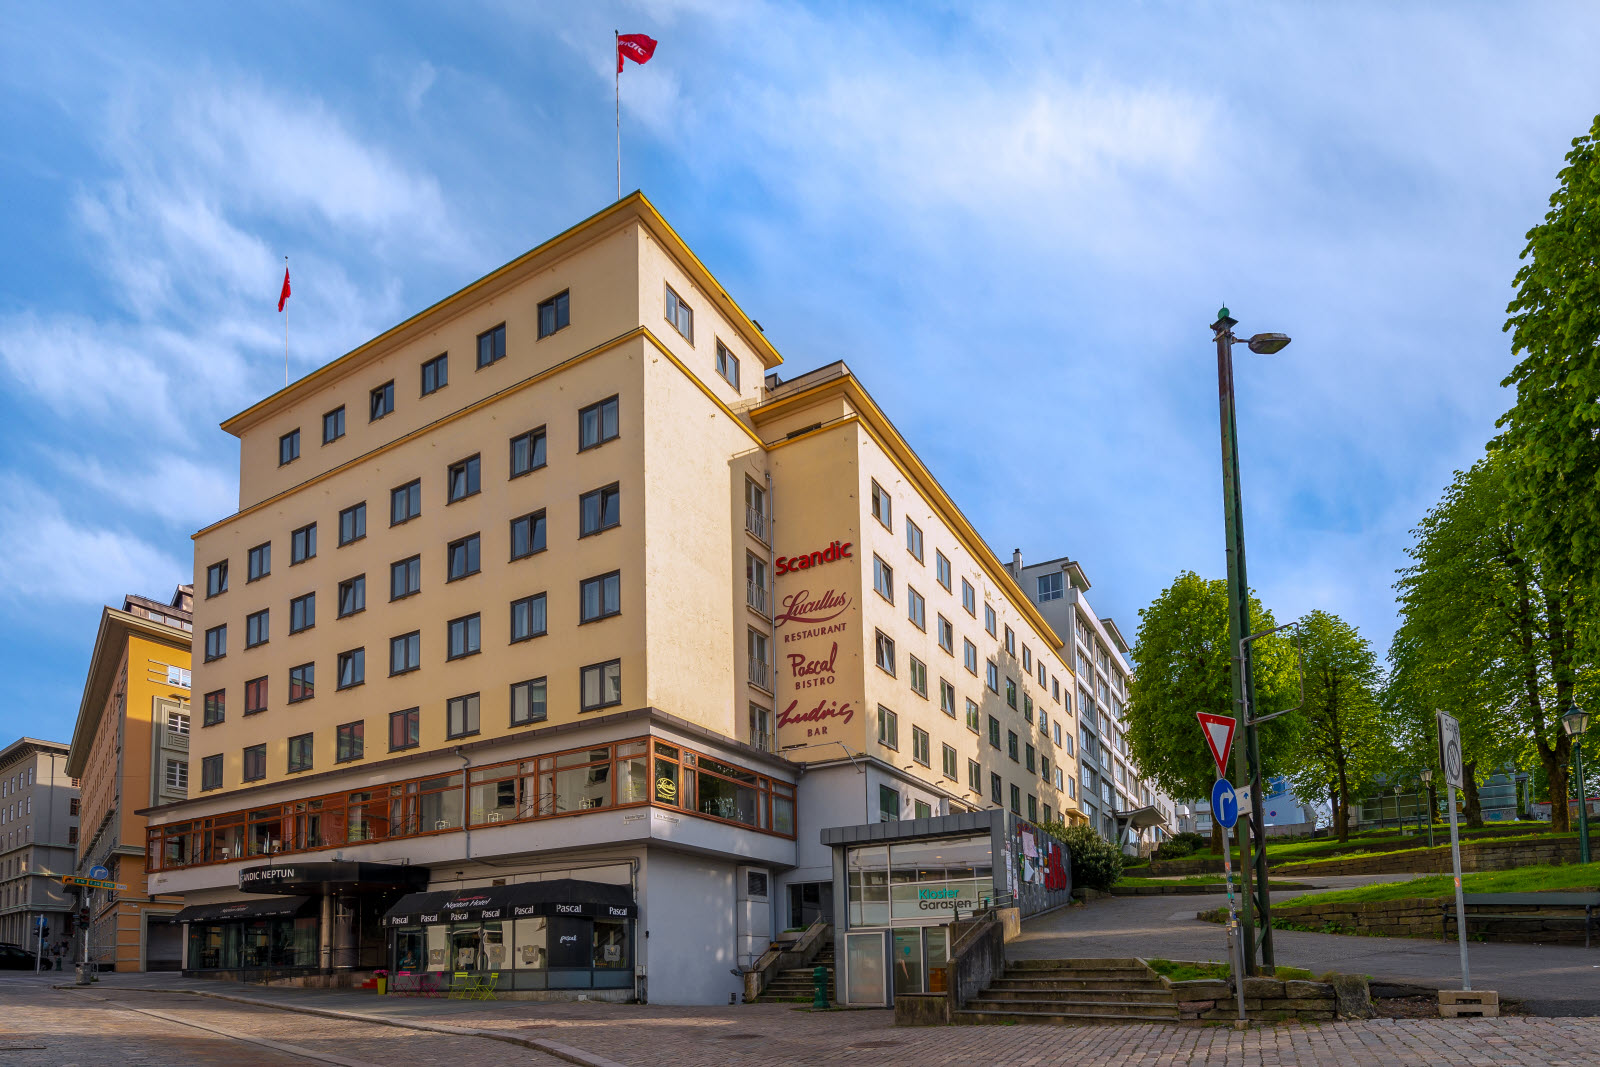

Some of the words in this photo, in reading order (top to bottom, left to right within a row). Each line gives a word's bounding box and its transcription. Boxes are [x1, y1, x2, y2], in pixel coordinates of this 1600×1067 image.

[775, 540, 853, 576] Scandic
[774, 589, 852, 628] Lucullus
[784, 622, 847, 643] RESTAURANT
[786, 641, 838, 677] Pascal
[795, 675, 835, 690] BISTRO
[807, 726, 828, 738] BAR
[261, 868, 295, 880] NEPTUN
[918, 887, 960, 900] Kloster
[481, 908, 501, 918] Pascal
[514, 905, 534, 915] Pascal
[556, 904, 582, 913] Pascal
[609, 906, 628, 916] Pascal
[391, 916, 409, 925] Pascal
[420, 914, 438, 923] Pascal
[450, 911, 469, 921] Pascal
